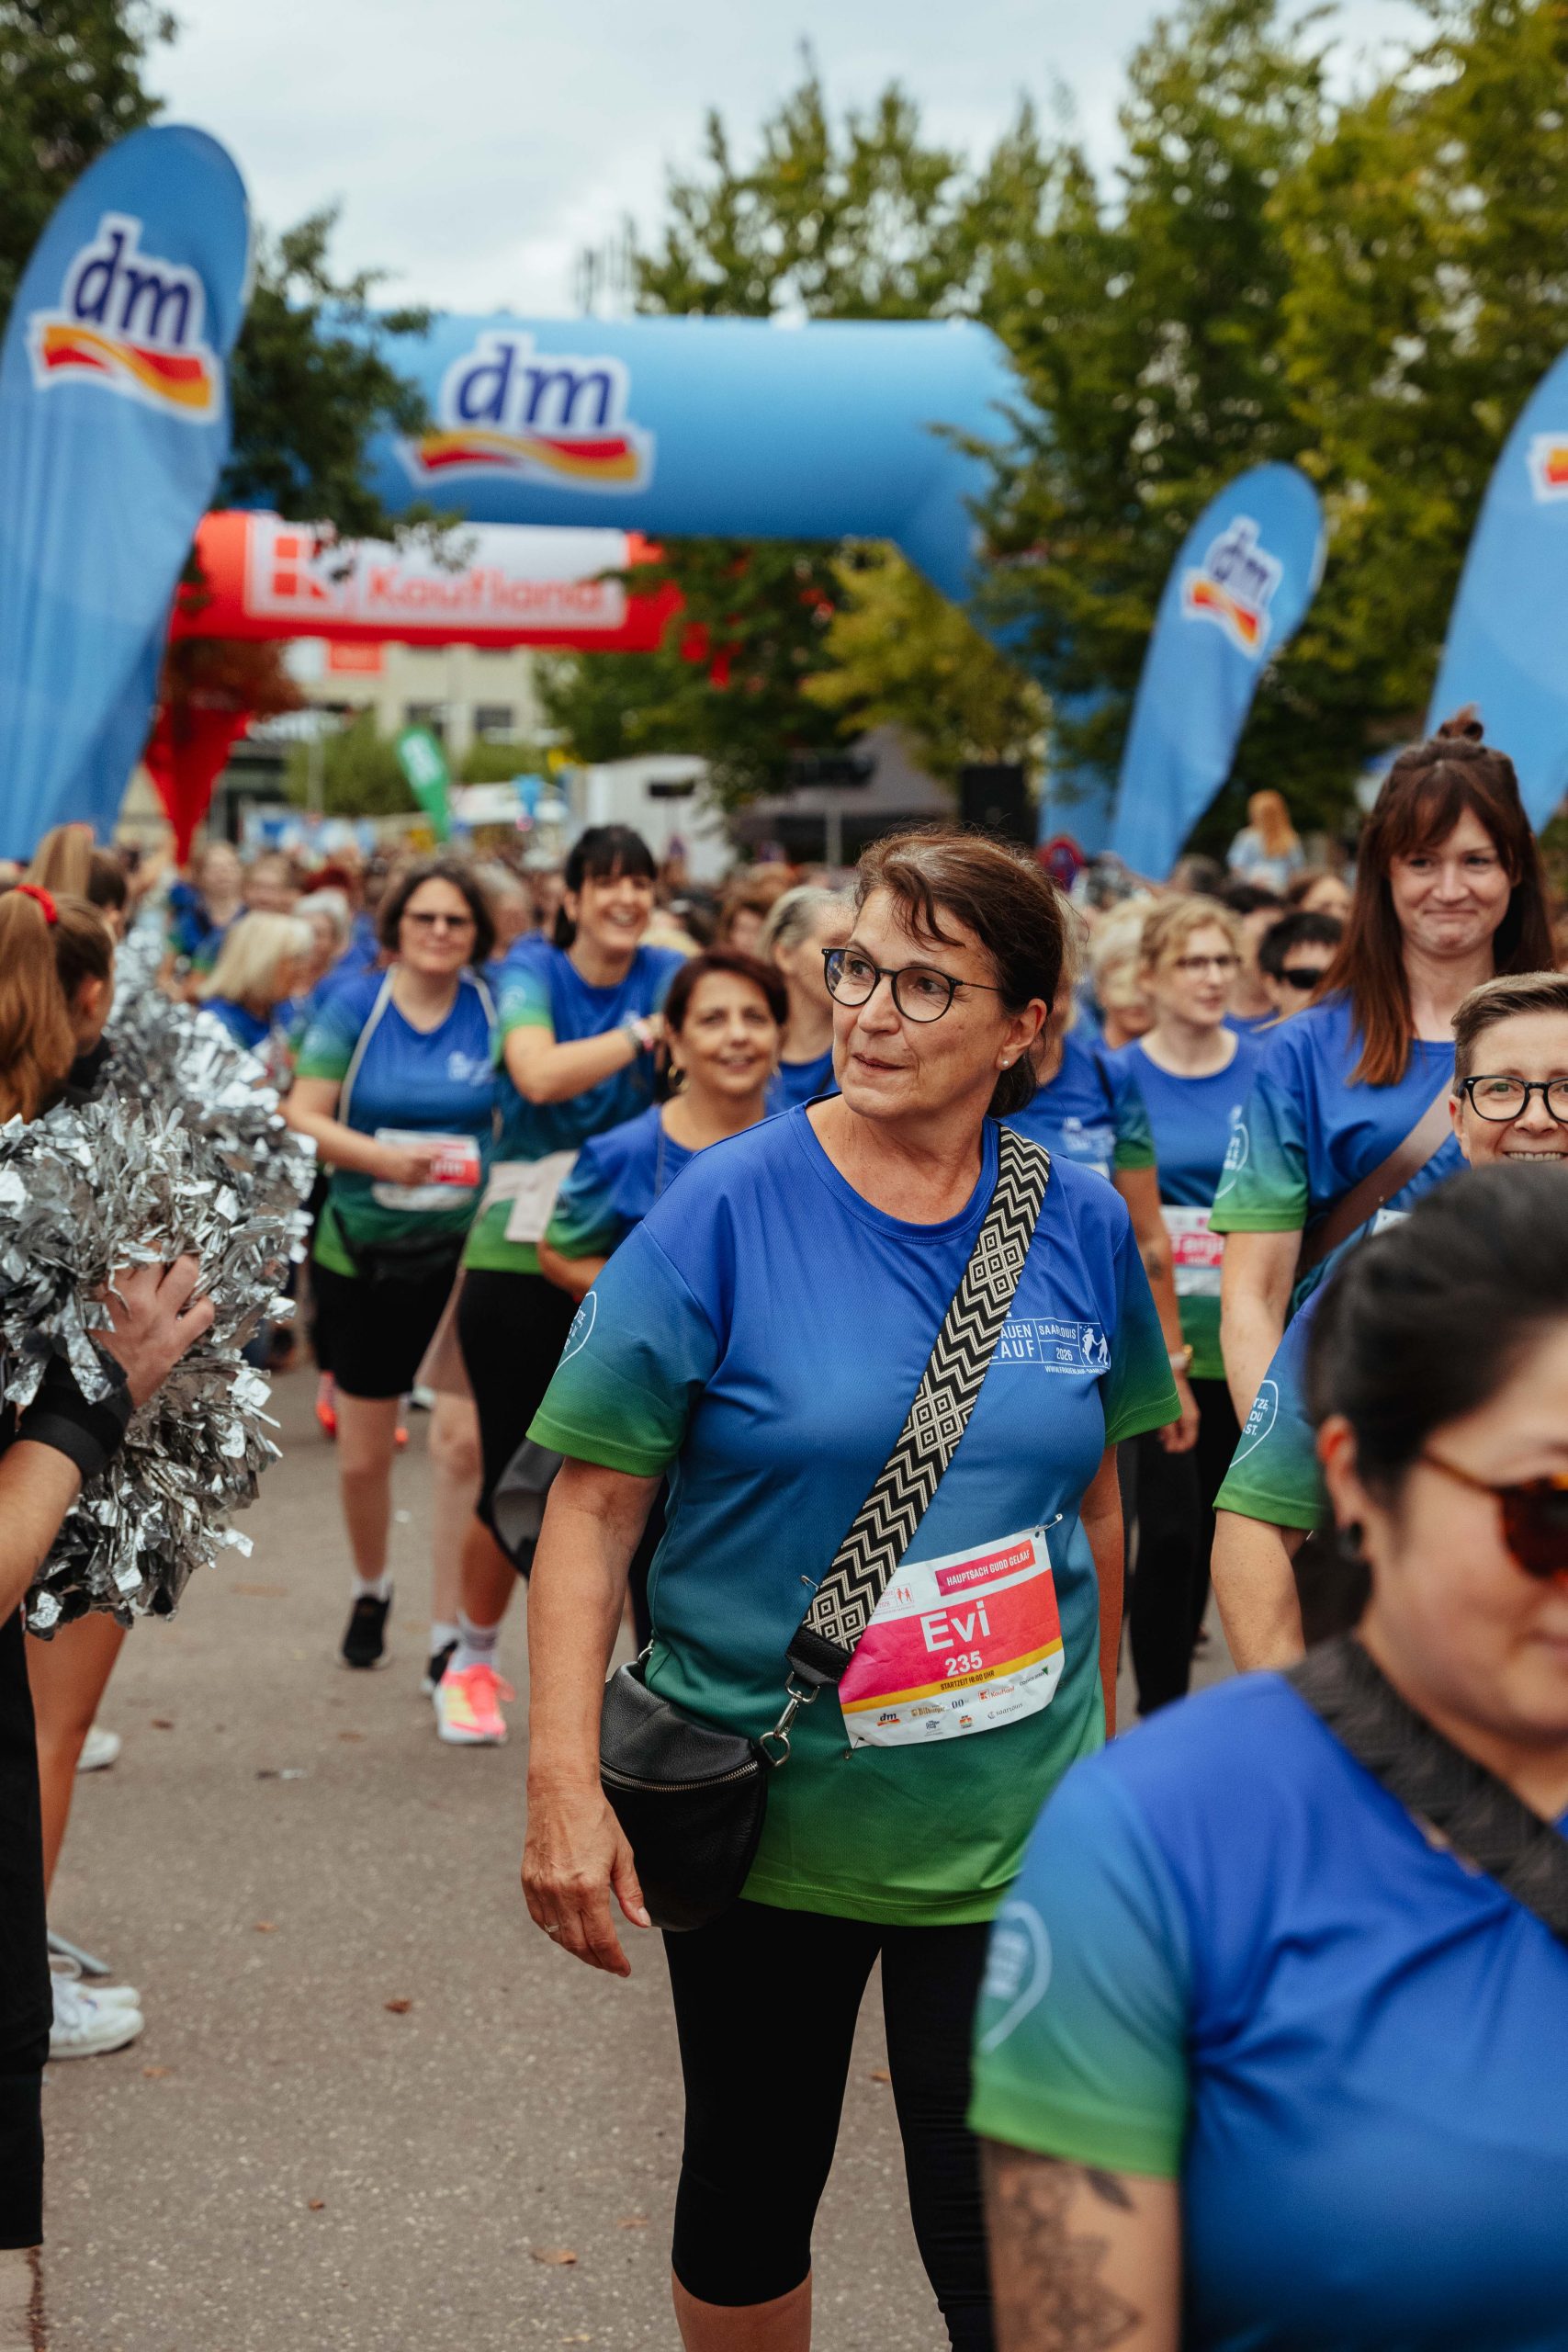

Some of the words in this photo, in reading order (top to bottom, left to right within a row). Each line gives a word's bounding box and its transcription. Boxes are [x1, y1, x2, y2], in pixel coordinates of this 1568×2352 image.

[74, 232, 191, 345] dm
[457, 343, 612, 425] dm
[1000, 1324, 1032, 1339] AUEN
[1055, 1347, 1073, 1361] 2026
[1249, 1410, 1263, 1422] DU
[946, 1566, 989, 1587] HAUPTSACH
[919, 1600, 991, 1653] Evi
[944, 1650, 983, 1677] 235
[940, 1677, 968, 1690] STARTZEIT
[983, 1669, 995, 1679] UHR
[879, 1713, 897, 1722] dm
